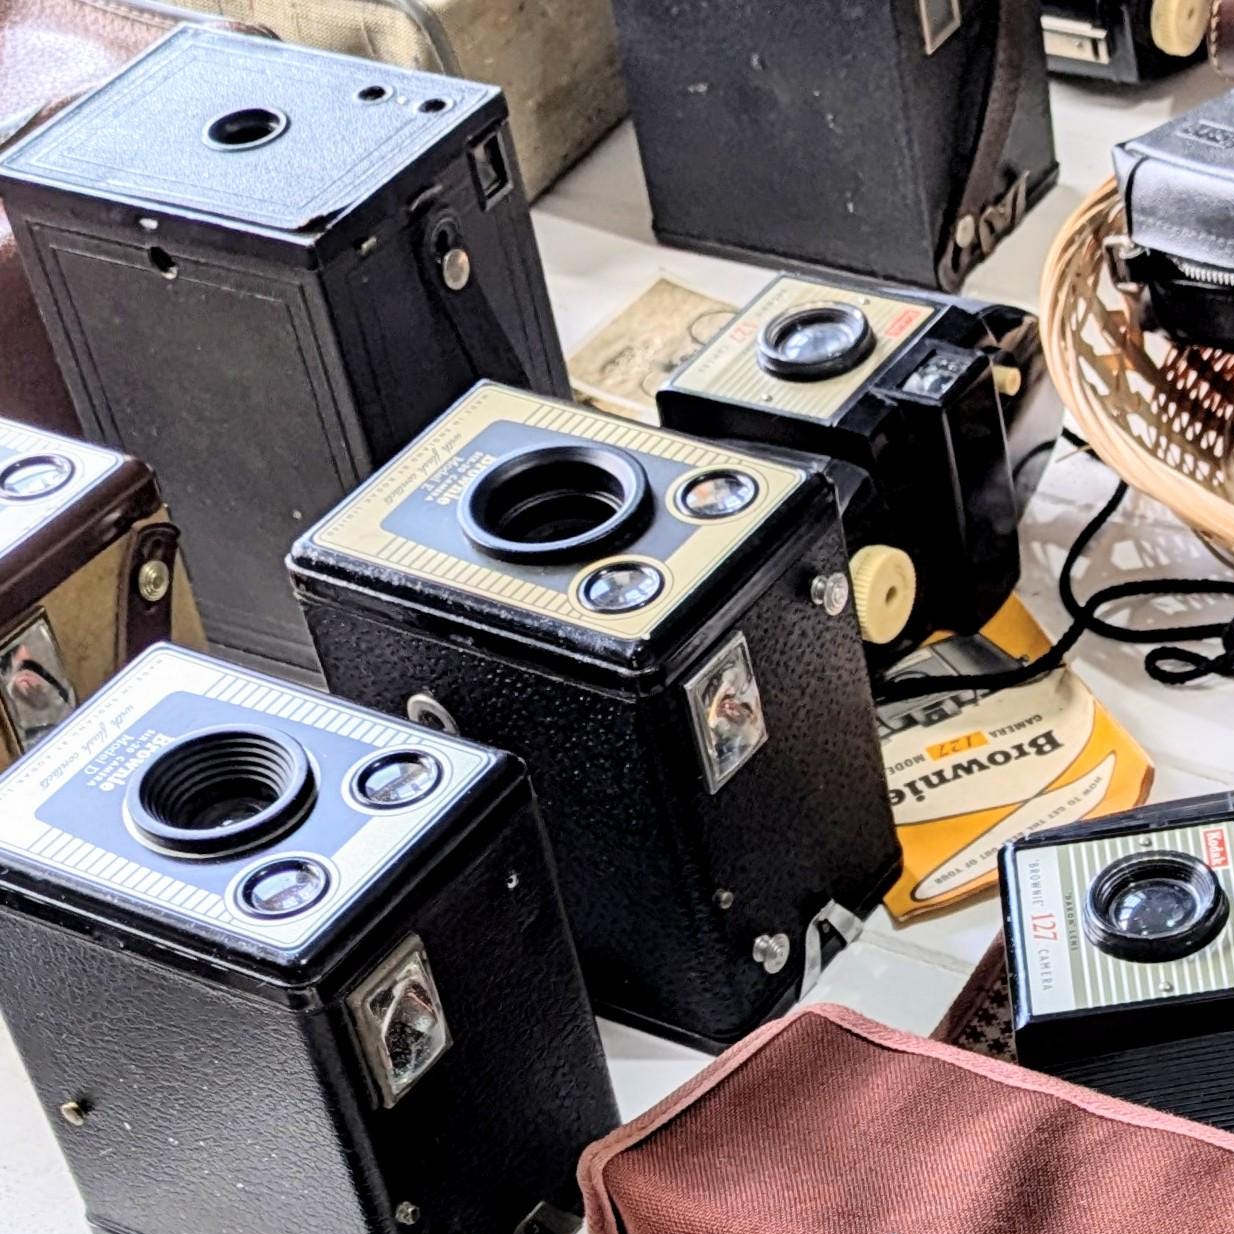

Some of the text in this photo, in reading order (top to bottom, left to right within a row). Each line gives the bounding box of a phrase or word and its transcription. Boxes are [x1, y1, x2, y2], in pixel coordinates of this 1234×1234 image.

[436, 453, 498, 506] Brownie
[988, 714, 1043, 740] CAMERA
[100, 734, 136, 765] Model
[938, 735, 972, 757] 127
[86, 755, 126, 788] CAMERA
[99, 733, 178, 792] Brownie
[1082, 776, 1103, 797] HOW
[1207, 831, 1229, 868] Kodak
[1031, 912, 1058, 943] 127
[1039, 949, 1055, 992] CAMERA
